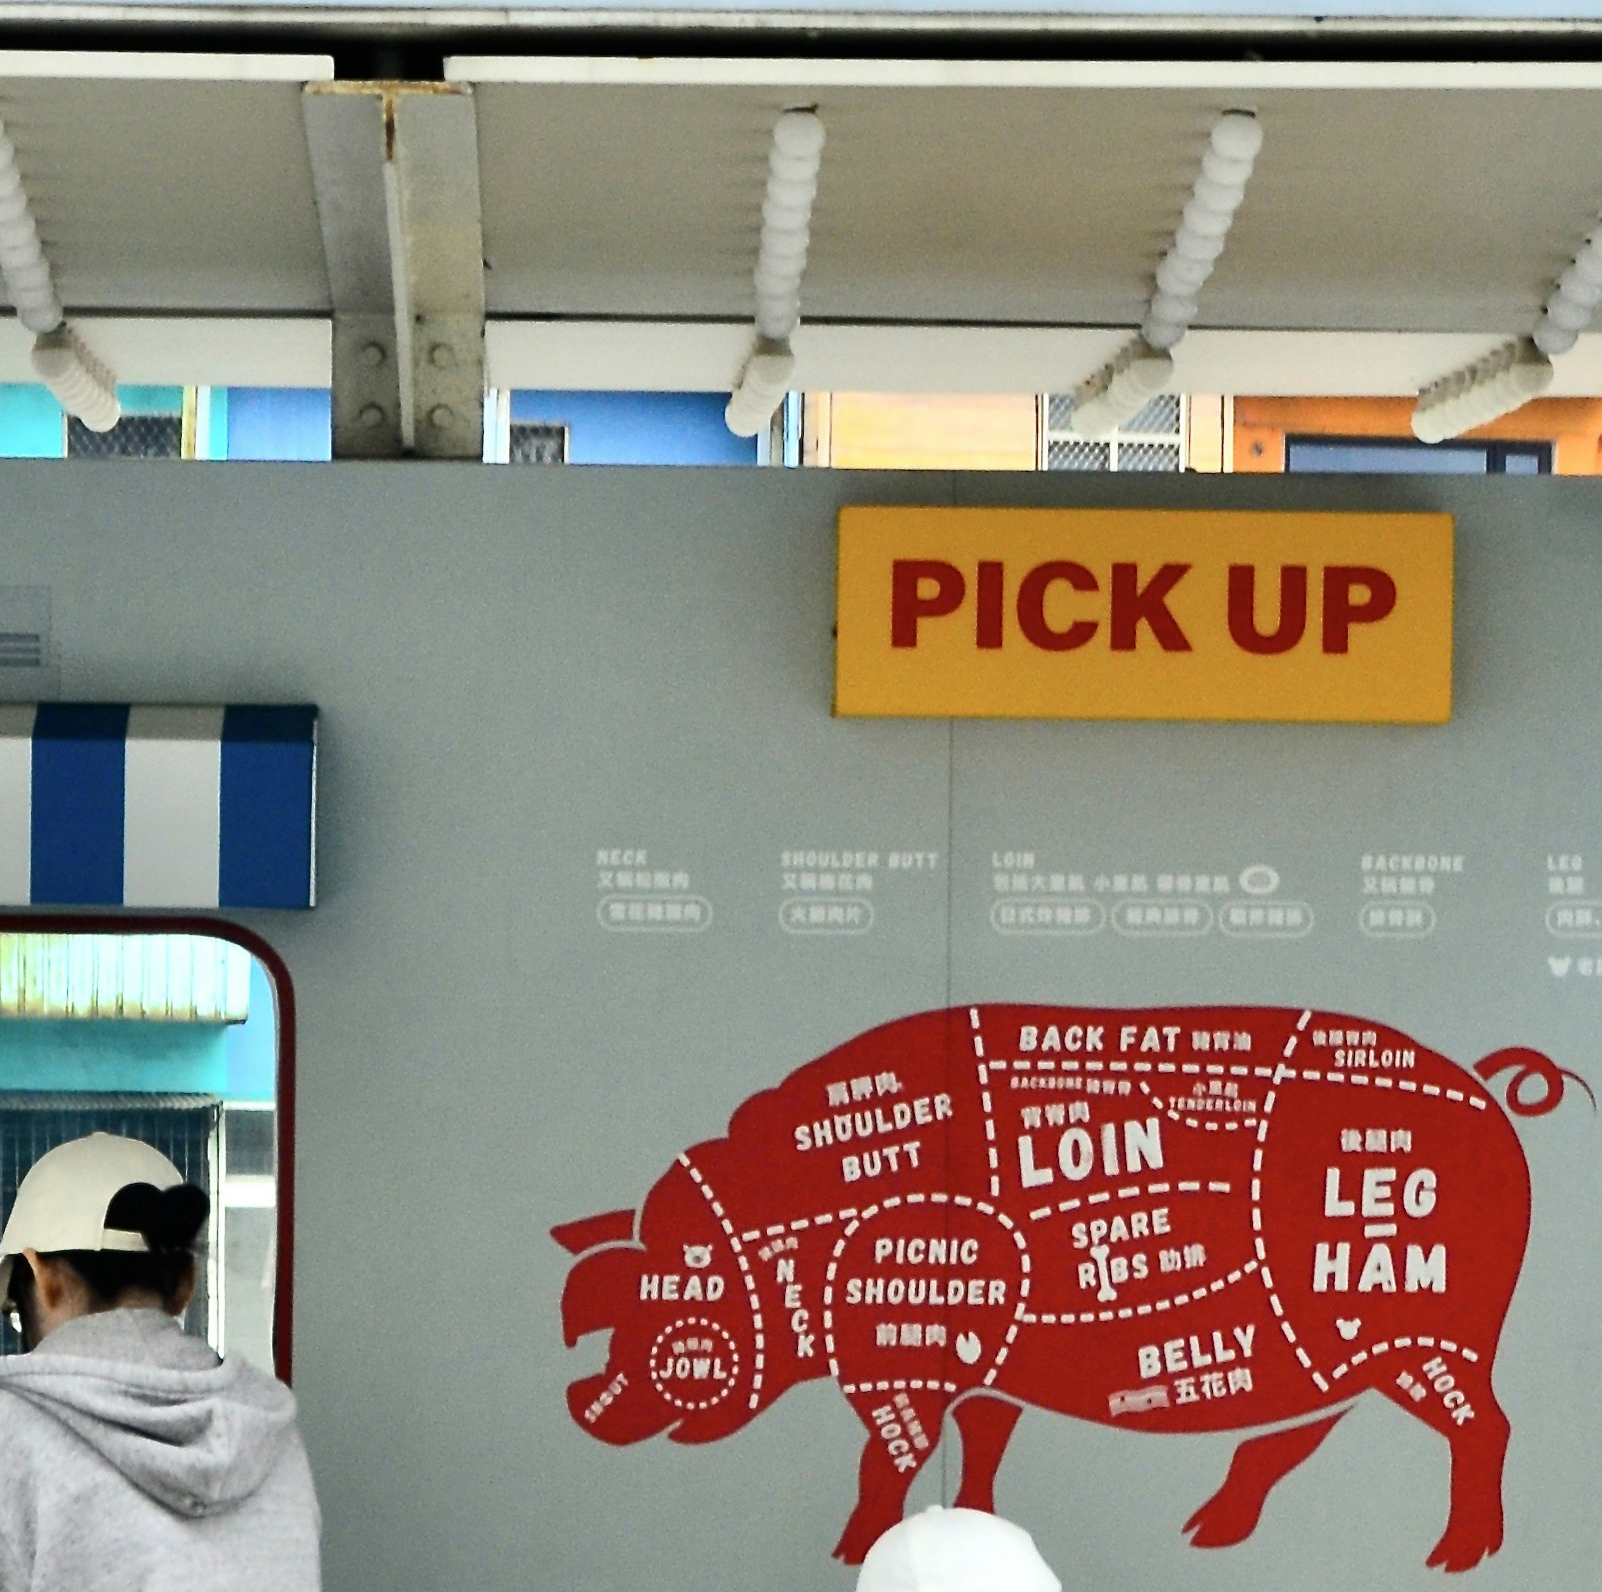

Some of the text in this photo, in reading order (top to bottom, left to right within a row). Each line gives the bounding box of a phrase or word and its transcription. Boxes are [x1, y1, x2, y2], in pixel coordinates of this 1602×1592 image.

[891, 559, 1397, 655] PICK UP
[781, 850, 939, 869] SHOULDER BUTT
[992, 851, 1035, 869] LOIN
[1361, 854, 1465, 872] BACKBONE
[1019, 1026, 1104, 1051] BACK
[1120, 1027, 1180, 1051] FAT
[1334, 1049, 1415, 1068] SIRLOIN
[795, 1093, 953, 1151] SHOULDER
[842, 1141, 920, 1182] BUTT
[1018, 1117, 1164, 1188] LOIN
[1325, 1166, 1438, 1218] LEG
[1072, 1209, 1171, 1248] SPARE
[875, 1238, 978, 1265] PICNIC
[1312, 1242, 1447, 1293] HAM
[640, 1274, 725, 1301] HEAD
[846, 1278, 1006, 1305] SHOULDER
[776, 1258, 815, 1358] NECK
[659, 1357, 727, 1379] JOWL
[1138, 1324, 1256, 1379] BELLY
[1174, 1367, 1254, 1405] 五花肉
[1422, 1356, 1476, 1426] HOCK
[872, 1405, 917, 1473] HOCK
